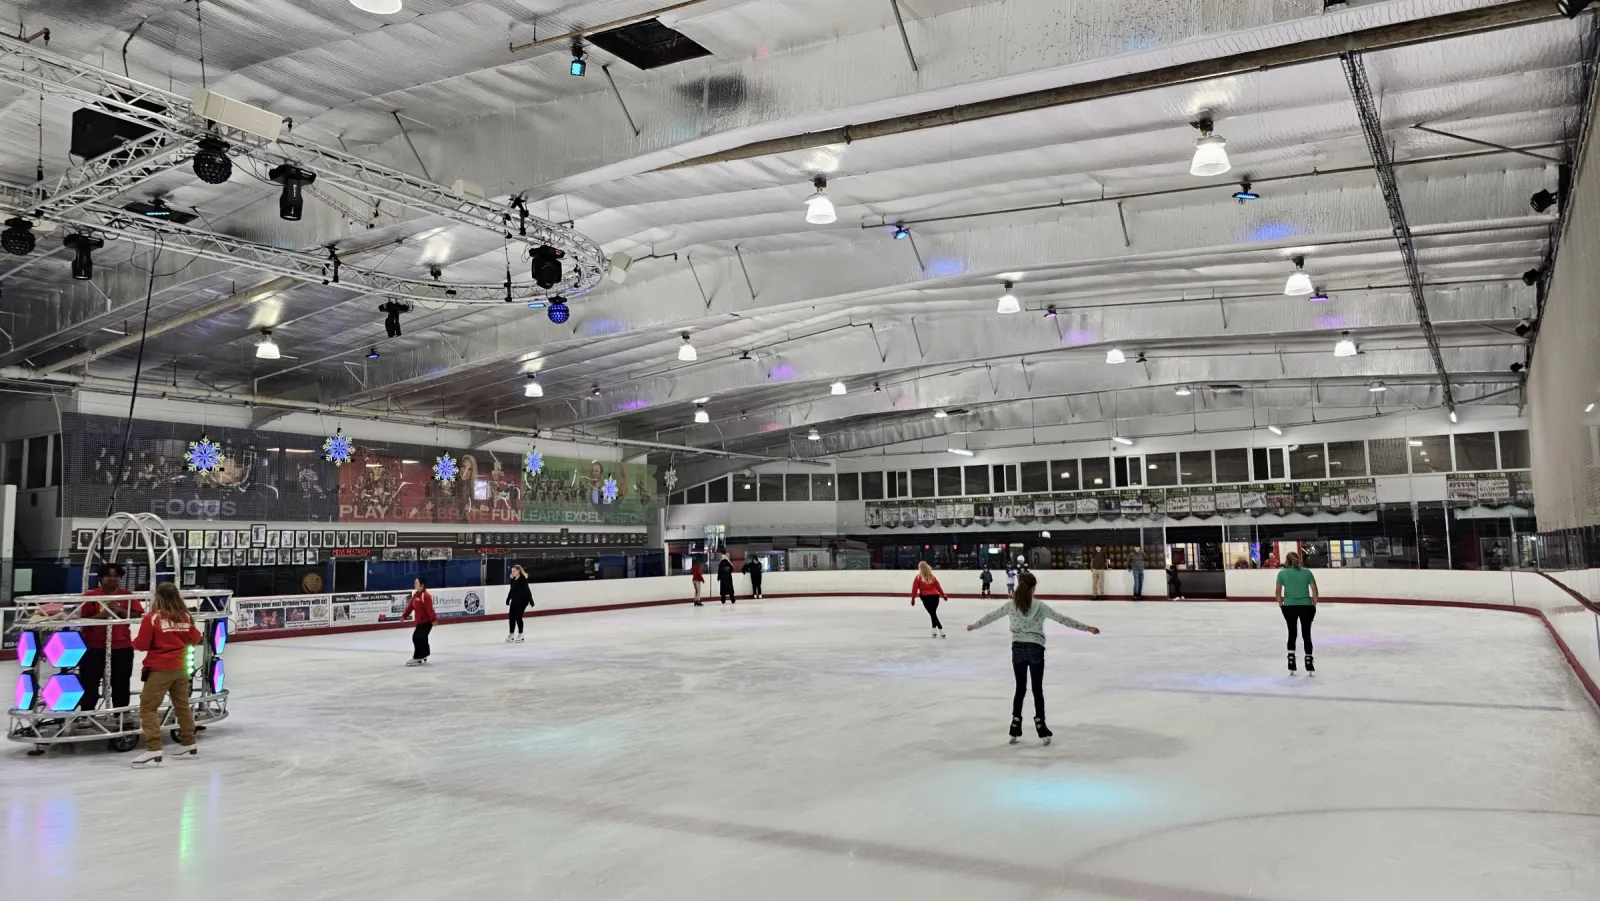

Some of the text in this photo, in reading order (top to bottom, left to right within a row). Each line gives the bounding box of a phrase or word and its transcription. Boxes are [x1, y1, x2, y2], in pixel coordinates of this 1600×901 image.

[151, 499, 237, 516] FOCUS
[339, 504, 389, 519] PLAY
[491, 508, 520, 521] FUN
[521, 510, 566, 522] LEARN
[565, 510, 602, 523] EXCEL
